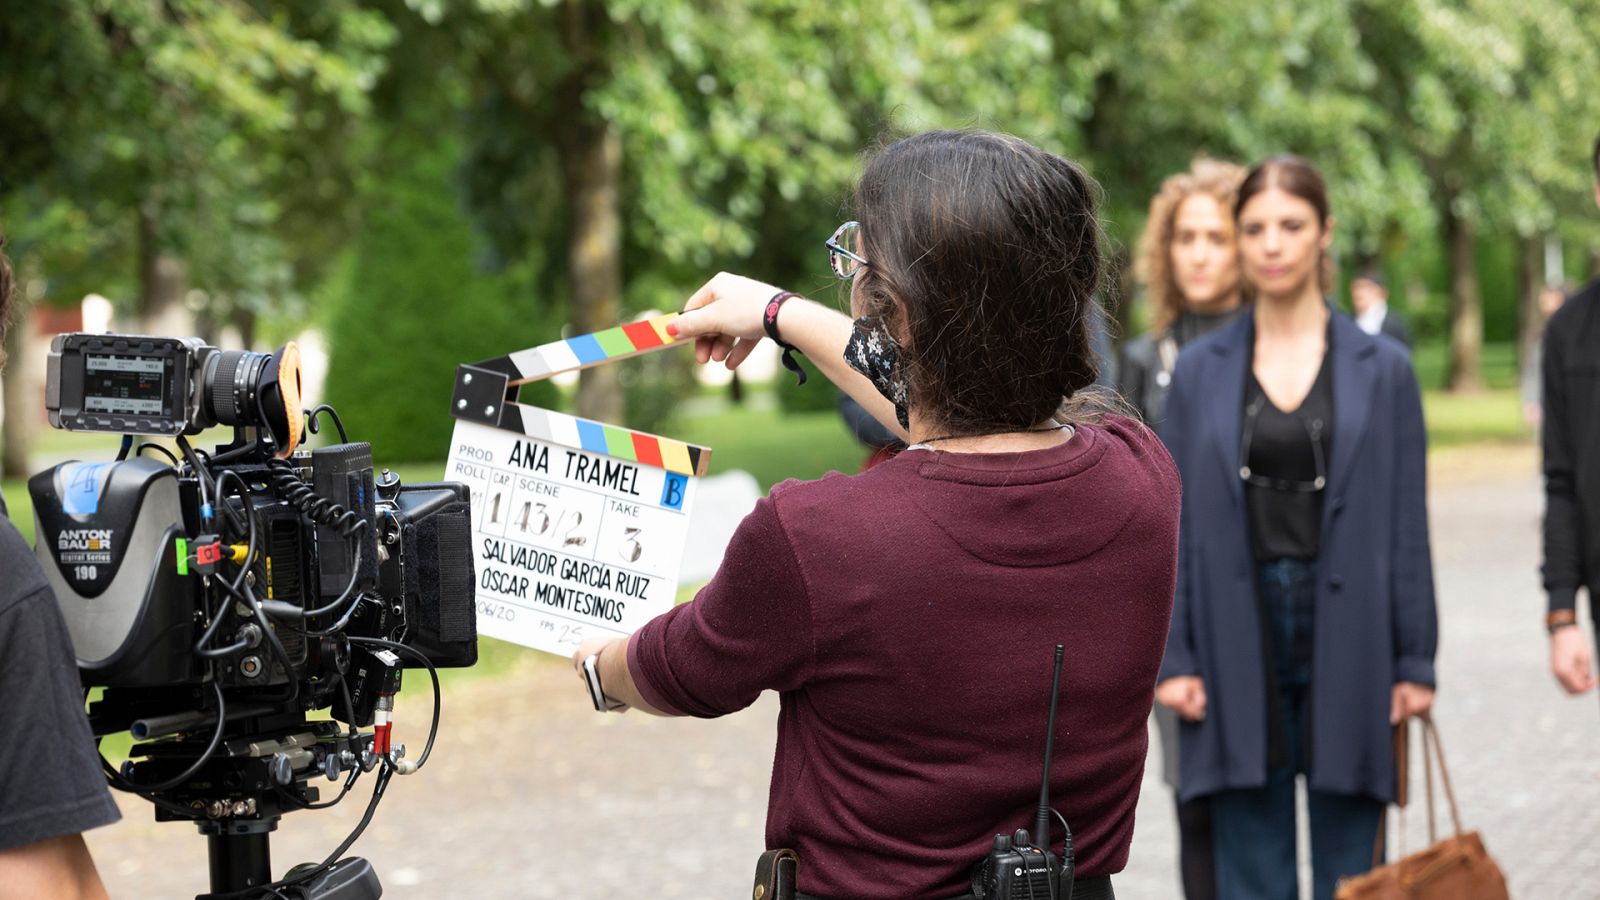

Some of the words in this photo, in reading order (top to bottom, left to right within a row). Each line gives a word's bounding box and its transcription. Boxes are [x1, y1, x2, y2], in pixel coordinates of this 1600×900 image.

[459, 444, 493, 462] PROD
[455, 463, 487, 480] ROLL
[508, 440, 549, 474] ANA
[565, 451, 640, 496] TRAMEL
[519, 479, 560, 498] SCENE
[663, 477, 682, 507] B
[610, 500, 640, 517] TAKE
[58, 530, 112, 540] ANTON
[58, 540, 111, 550] BAUER
[618, 527, 643, 563] 3
[74, 565, 97, 580] 190
[482, 537, 558, 577] SALVADOR
[560, 558, 611, 591] GARCÍA
[615, 570, 650, 600] RUIZ
[481, 566, 530, 599] ÓSCAR
[534, 581, 626, 623] MONTESINOS
[476, 599, 516, 622] 06/20
